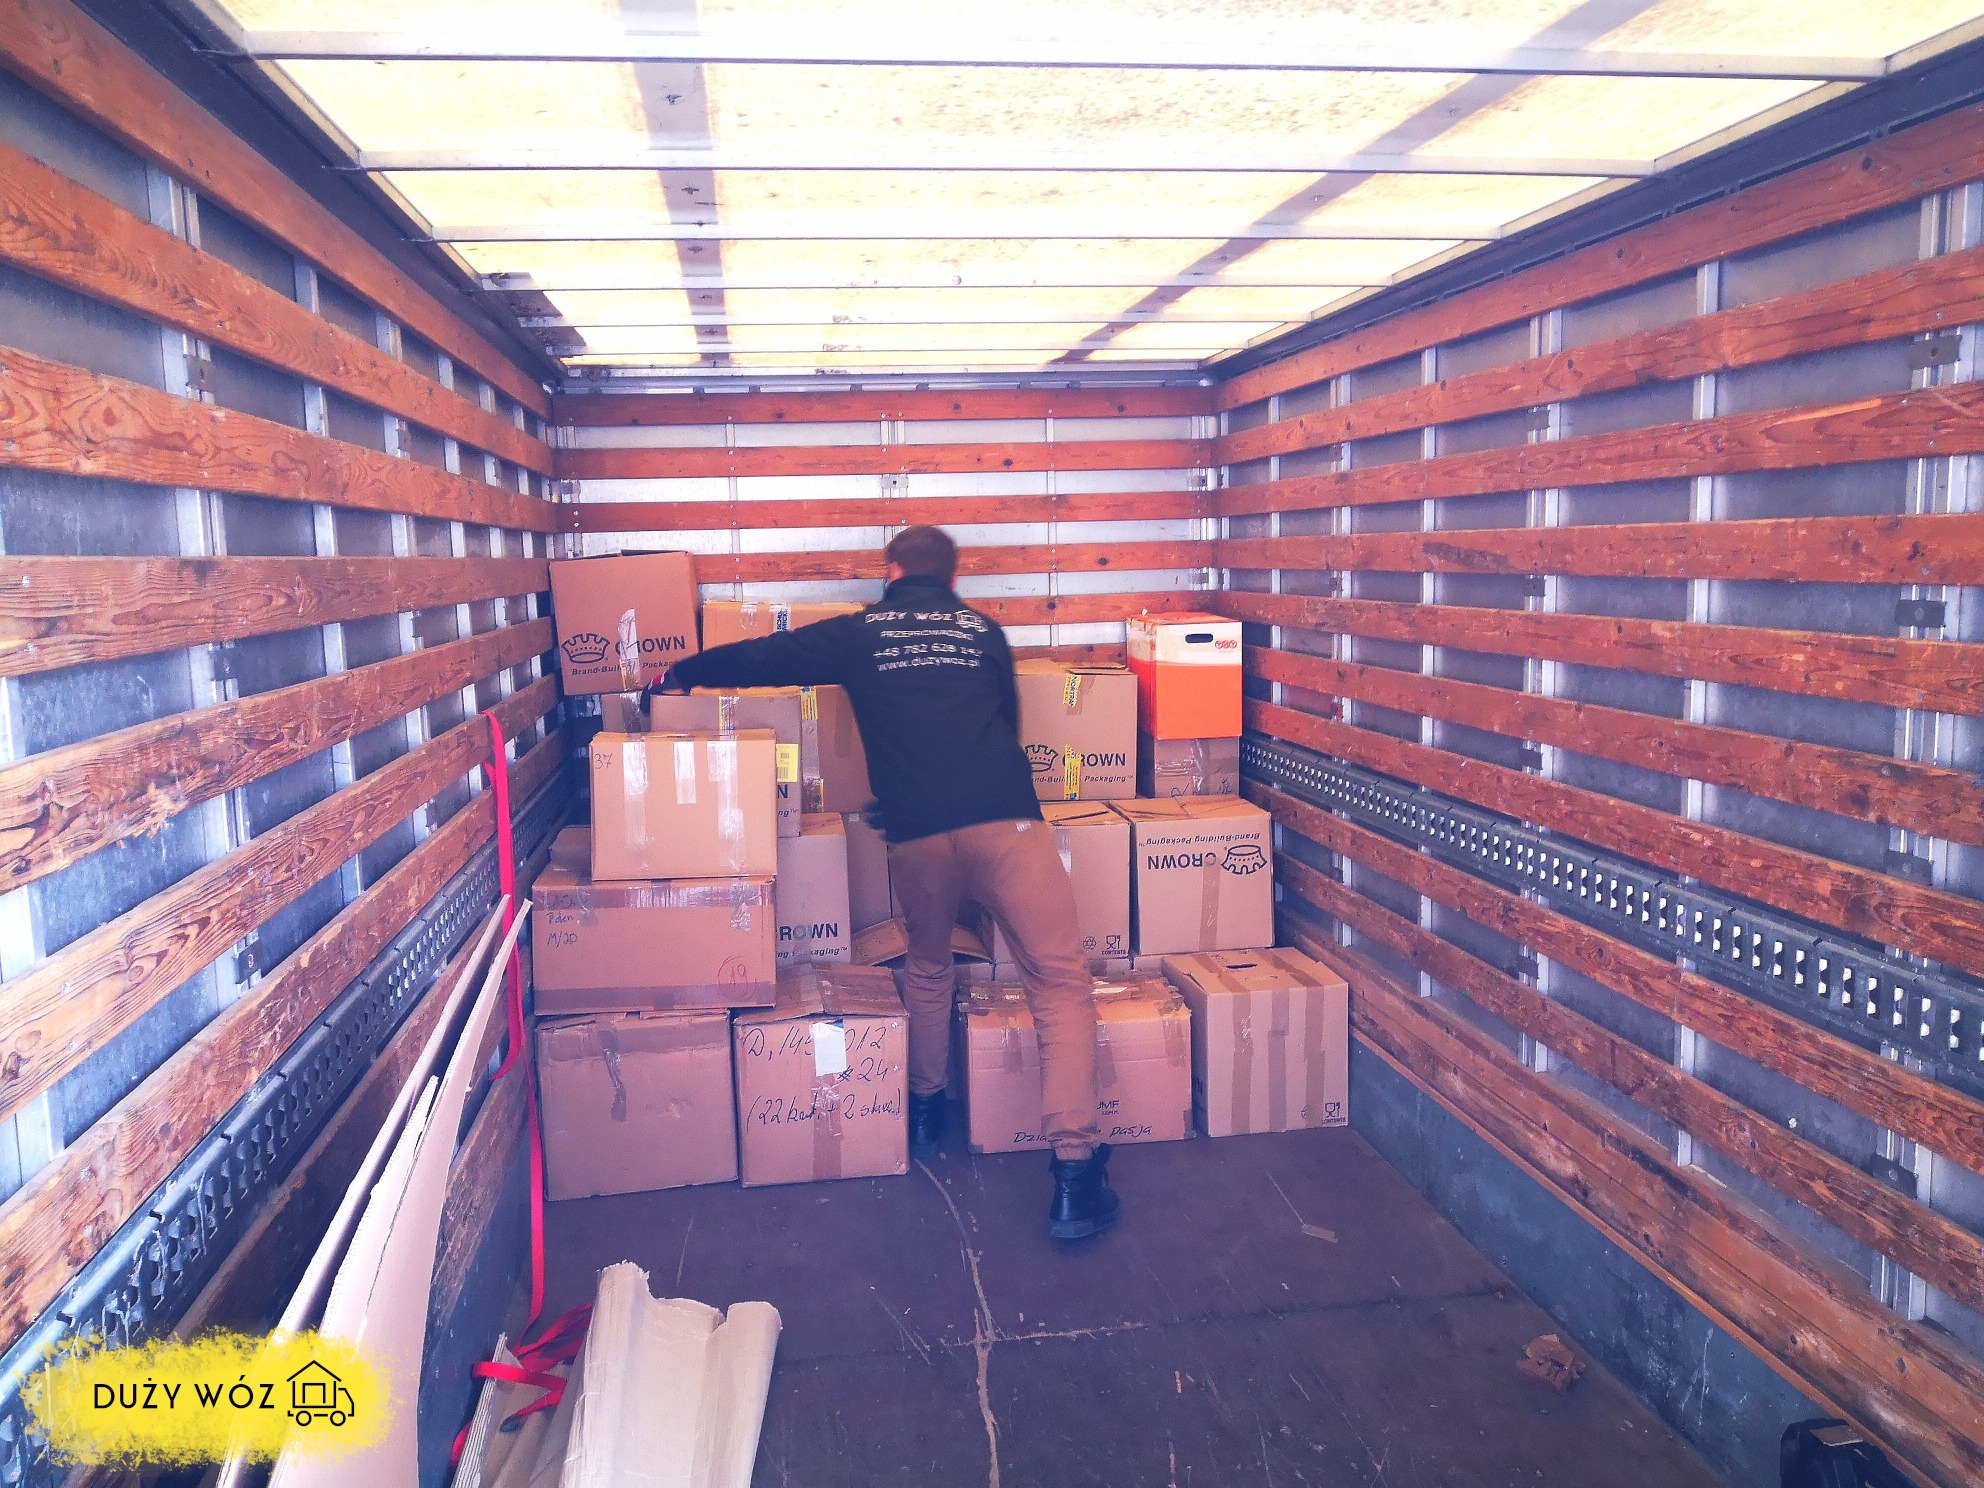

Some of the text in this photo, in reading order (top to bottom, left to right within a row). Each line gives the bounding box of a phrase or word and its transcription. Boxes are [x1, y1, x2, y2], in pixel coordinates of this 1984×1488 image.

[615, 635, 687, 656] COWN
[1147, 852, 1217, 870] CROWN
[779, 922, 838, 942] ROWN
